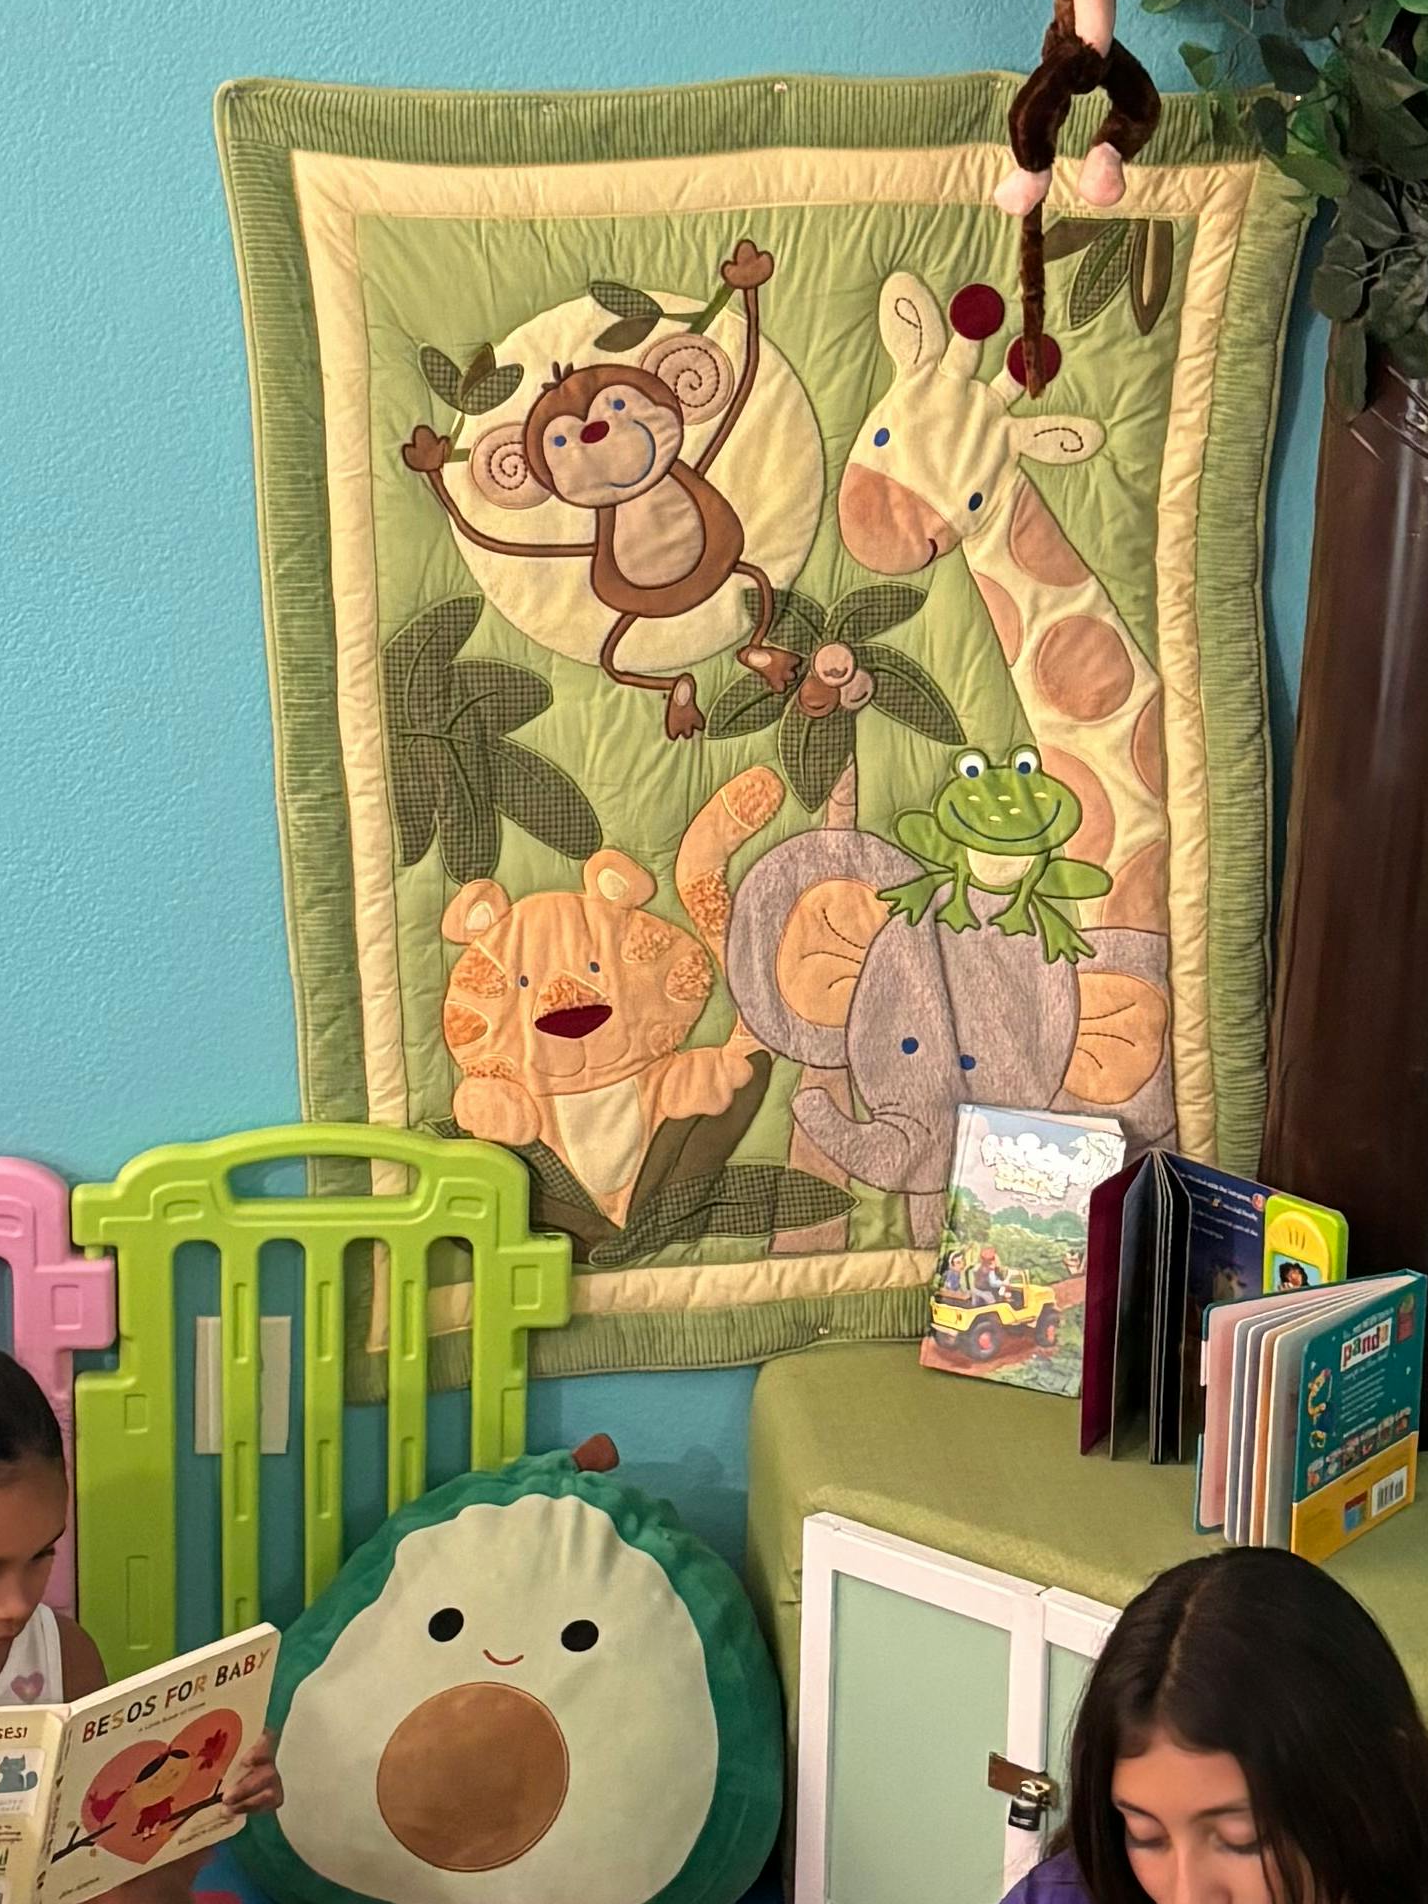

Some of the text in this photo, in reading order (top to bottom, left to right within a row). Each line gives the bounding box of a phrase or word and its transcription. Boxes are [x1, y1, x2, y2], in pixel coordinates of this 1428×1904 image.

[82, 1695, 157, 1743] BESOS
[164, 1674, 209, 1709] FOR
[215, 1648, 271, 1687] BABY
